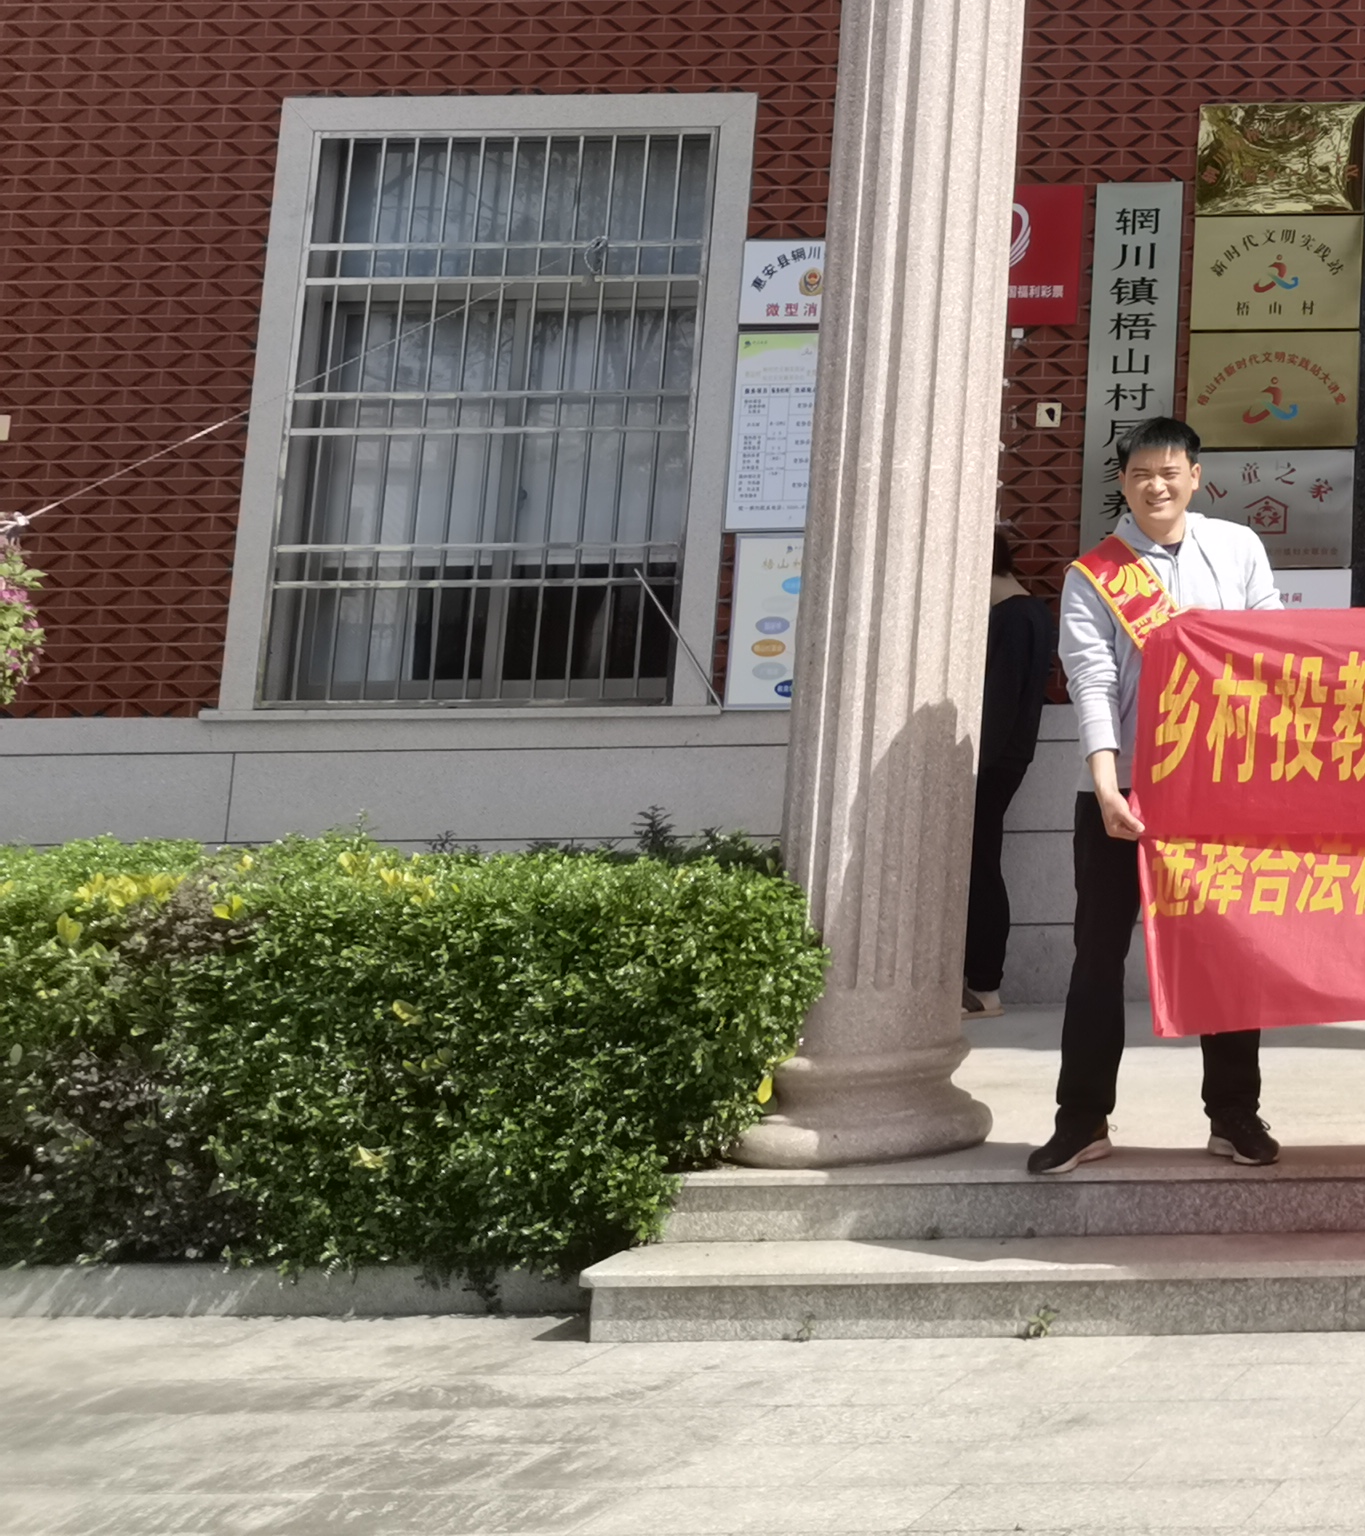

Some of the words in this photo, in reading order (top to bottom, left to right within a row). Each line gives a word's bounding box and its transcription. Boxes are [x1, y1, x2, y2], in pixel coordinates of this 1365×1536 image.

[1210, 228, 1344, 278] 新时代文明实践站
[1236, 300, 1315, 316] 梧山村
[1204, 462, 1334, 505] 儿童之家
